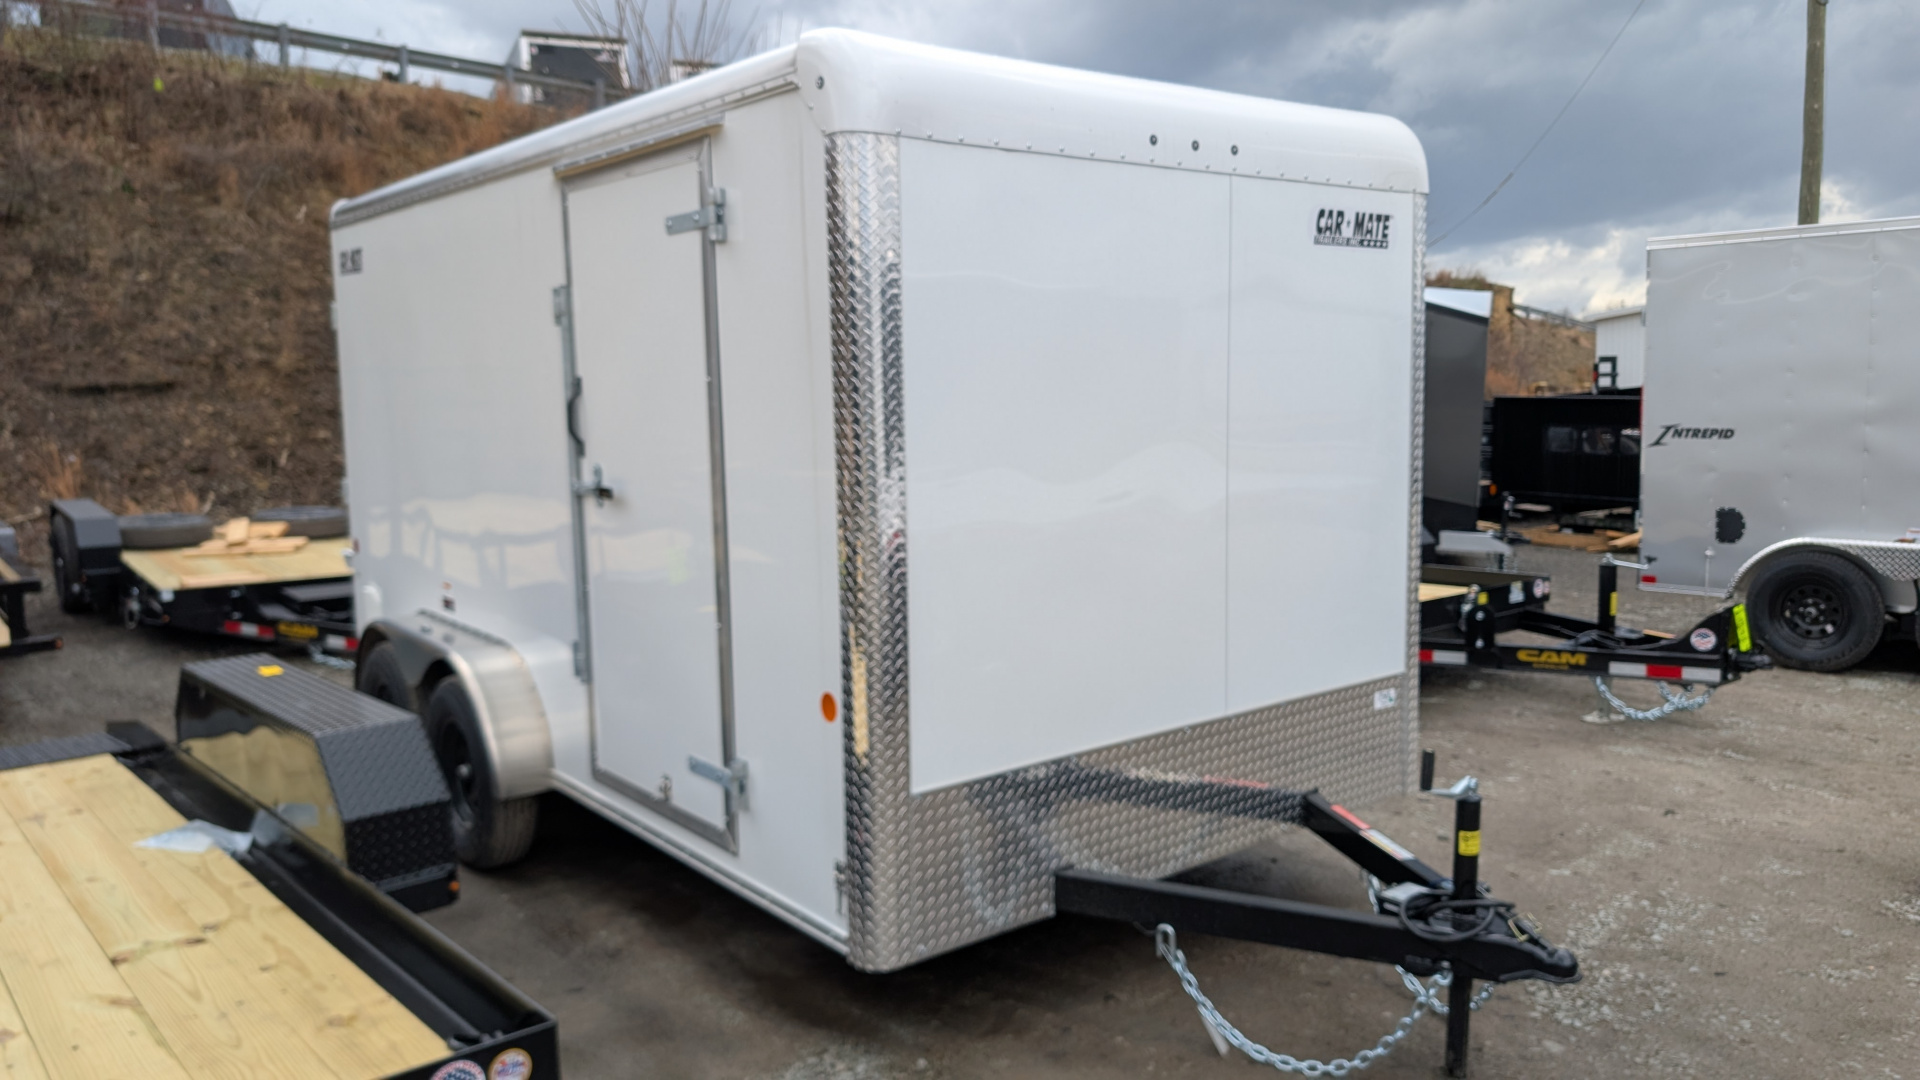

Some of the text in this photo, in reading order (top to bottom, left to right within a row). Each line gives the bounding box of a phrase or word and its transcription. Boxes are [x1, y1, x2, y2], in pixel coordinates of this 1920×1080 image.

[1316, 208, 1390, 239] CAR MATE
[1647, 423, 1735, 448] INTREPID
[1516, 649, 1587, 666] CAM
